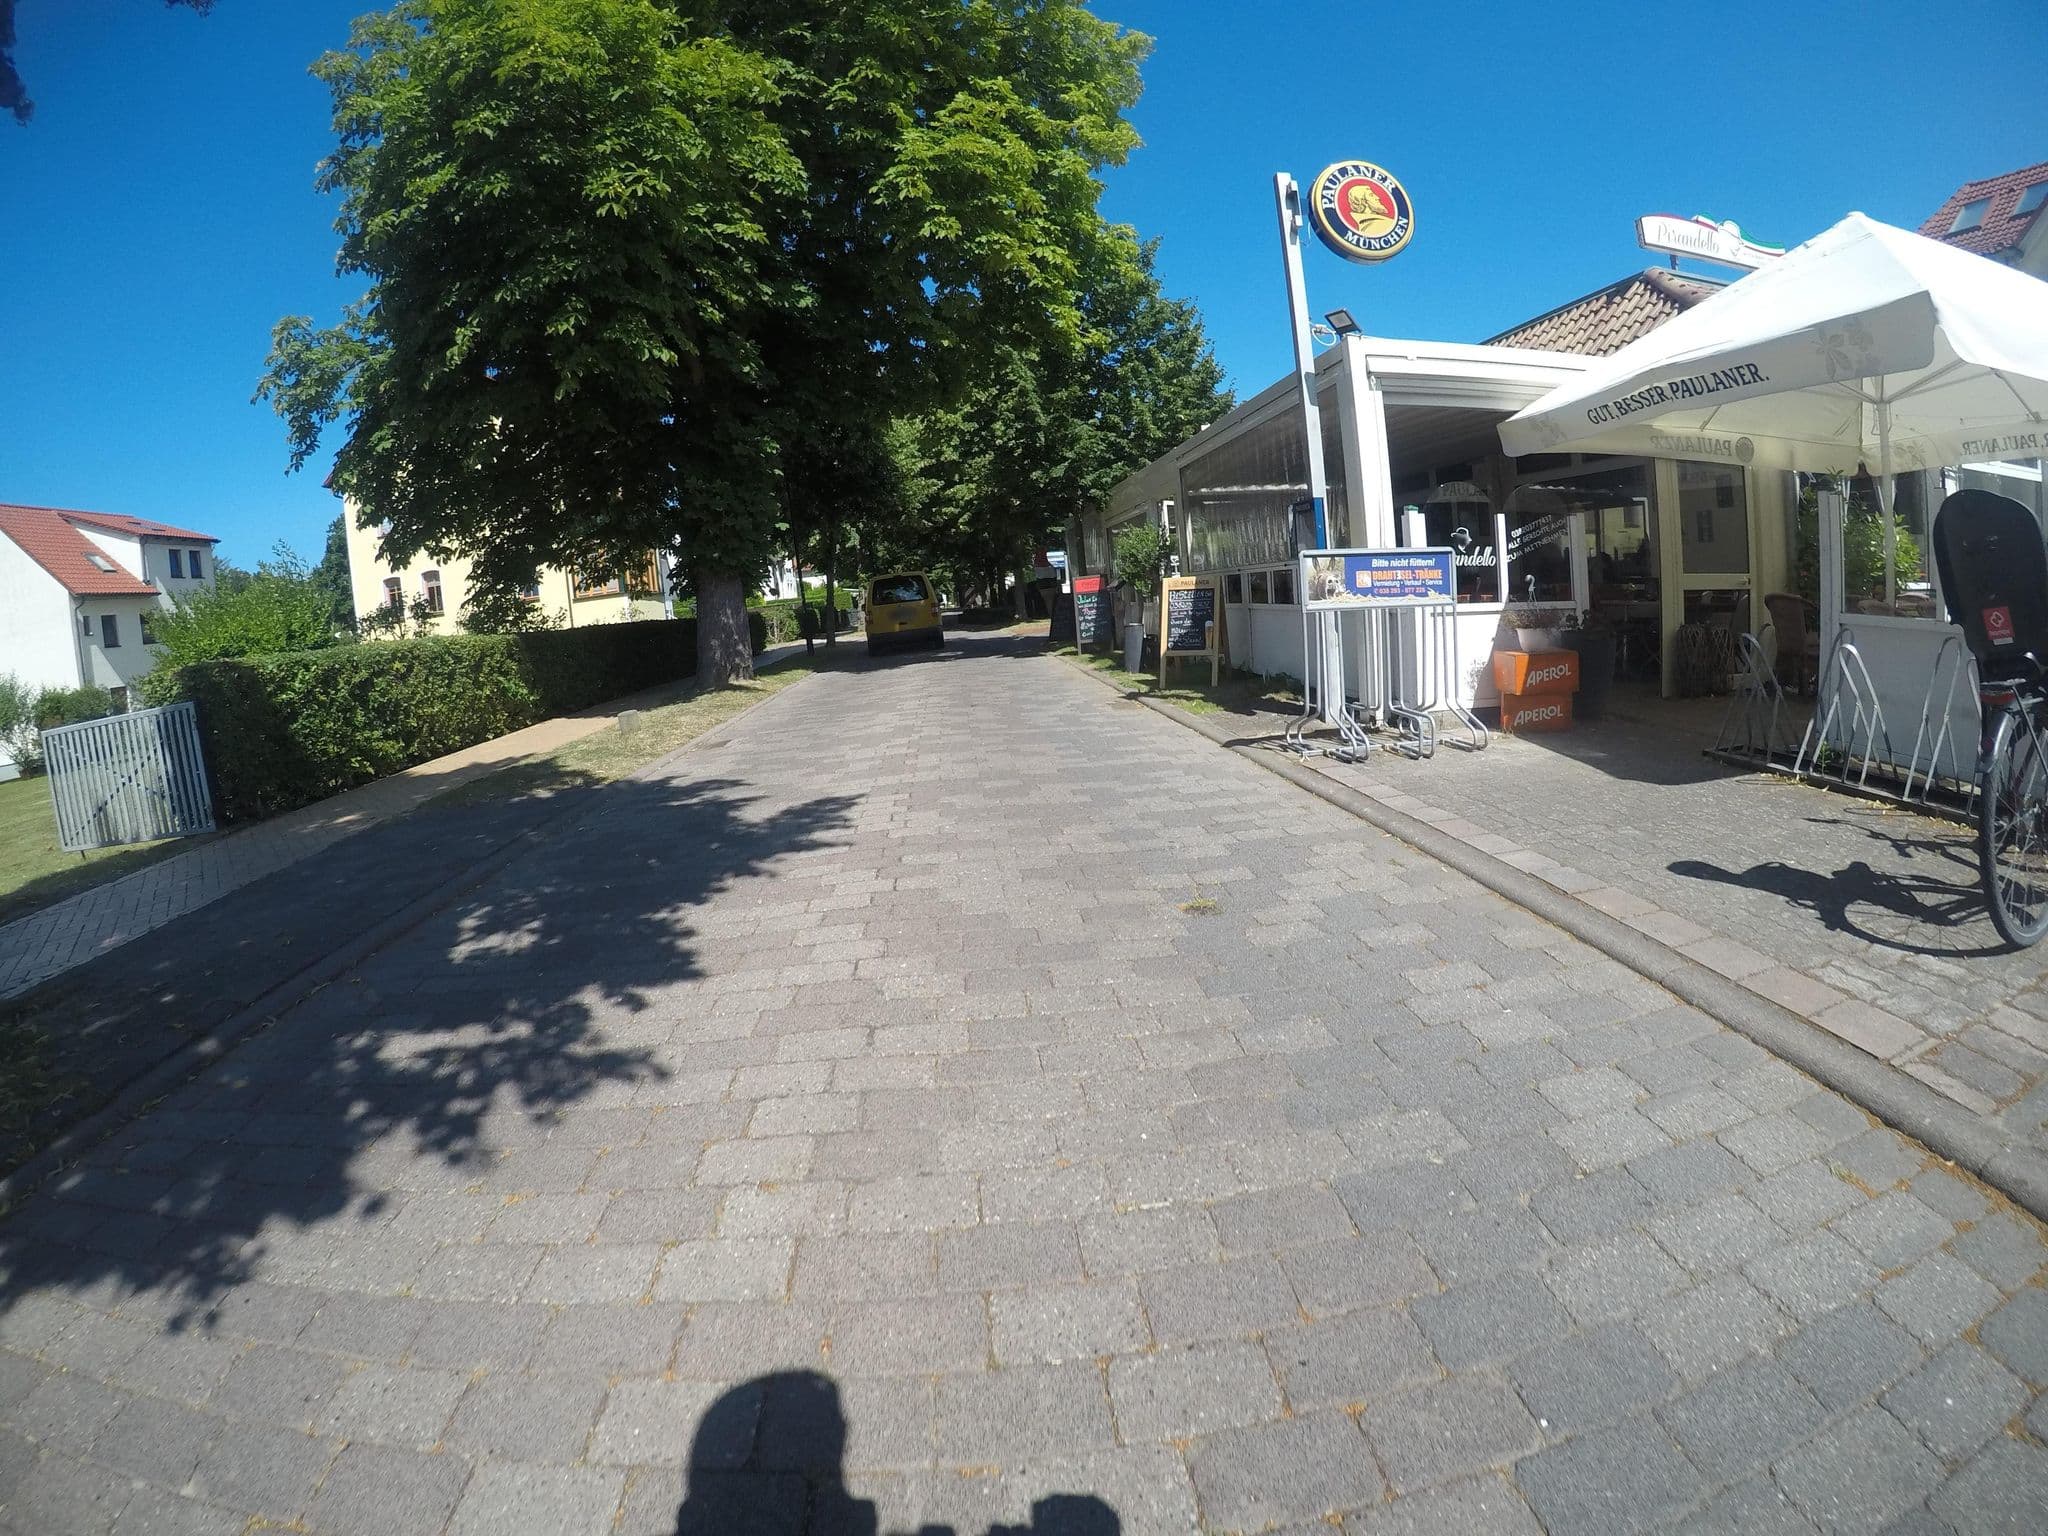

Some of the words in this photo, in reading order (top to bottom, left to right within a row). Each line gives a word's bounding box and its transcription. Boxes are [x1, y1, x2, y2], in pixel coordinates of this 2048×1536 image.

[1322, 165, 1397, 210] PAULANER
[1344, 215, 1408, 250] MÜNCHEN
[1657, 221, 1720, 253] Pirandello
[1667, 363, 1770, 399] PAULANER.
[1508, 538, 1522, 550] ALLE
[1371, 558, 1388, 568] Bitte
[1390, 558, 1408, 567] nicht
[1410, 557, 1435, 567] füttern!
[1526, 664, 1572, 688] APEROL
[1514, 705, 1564, 727] APEROL
